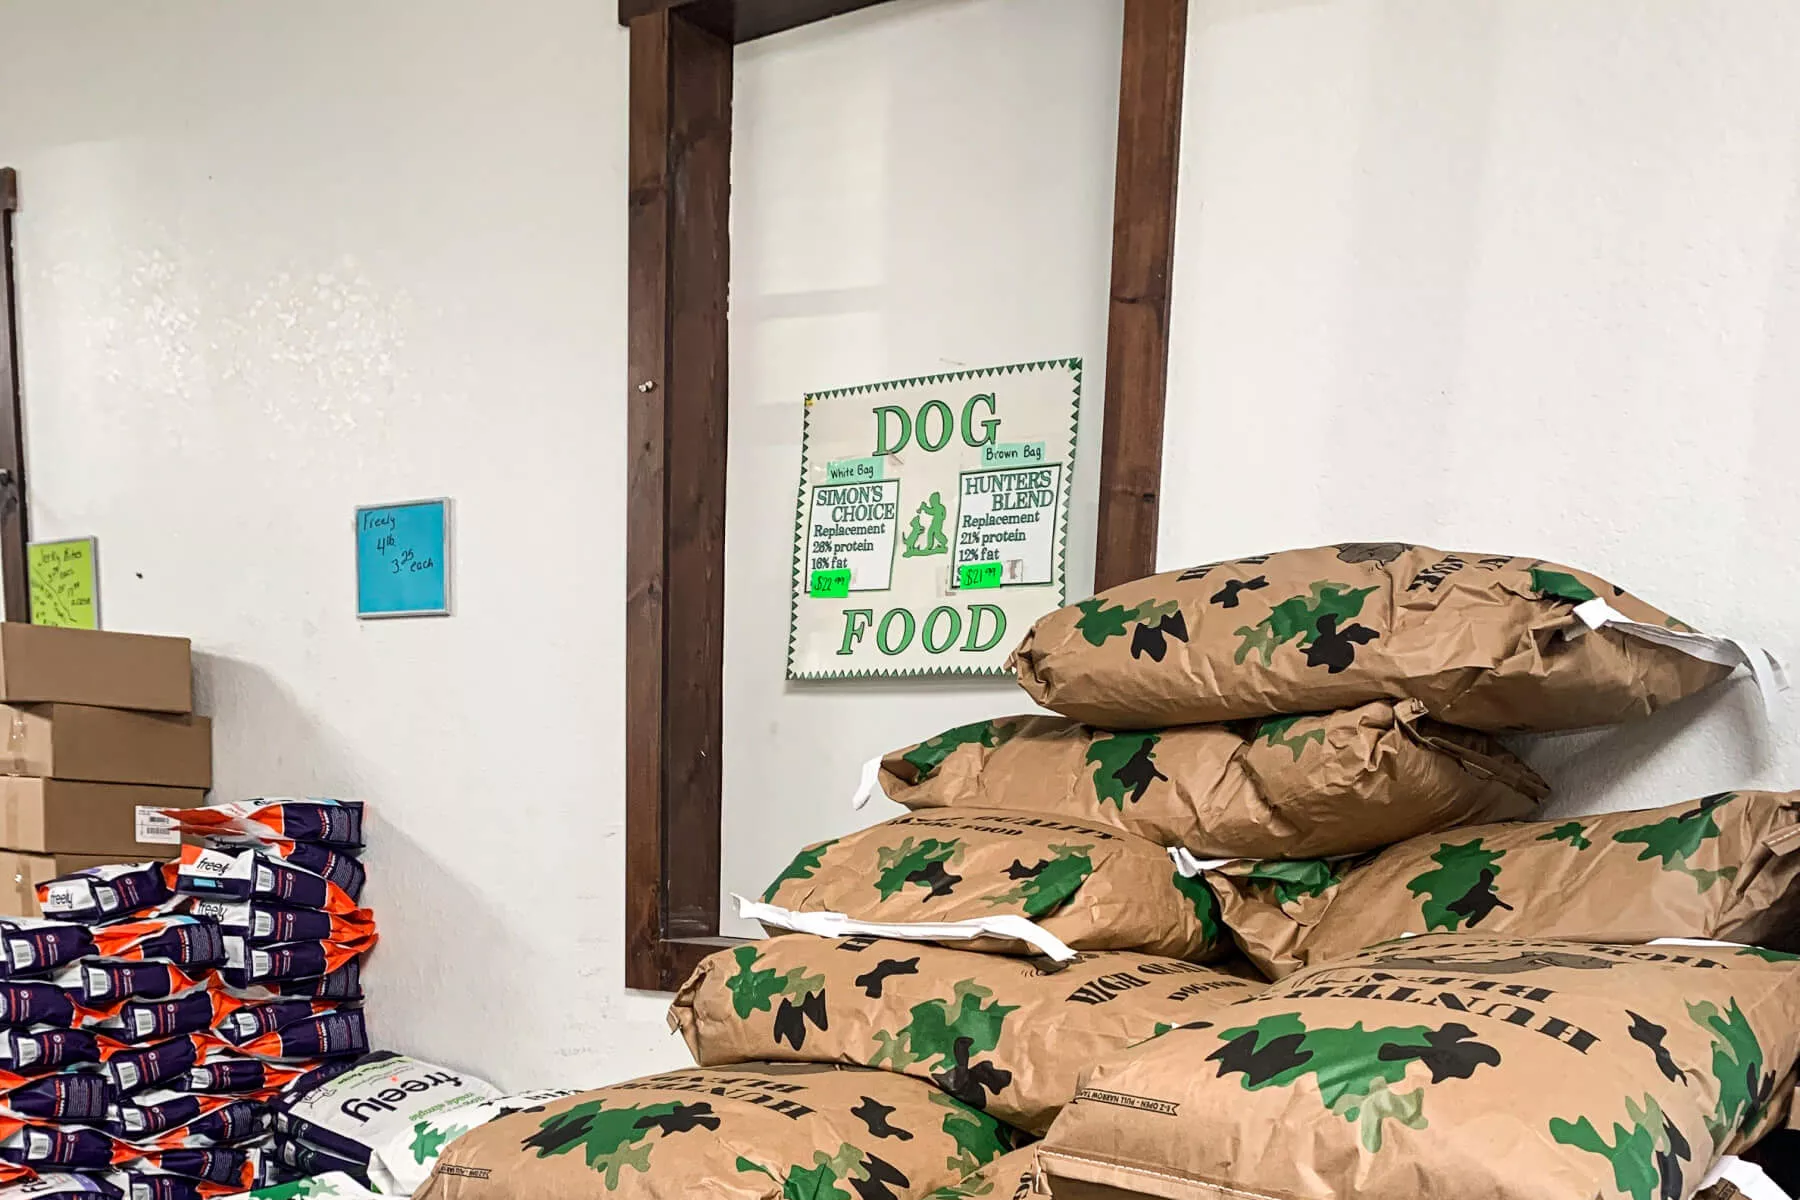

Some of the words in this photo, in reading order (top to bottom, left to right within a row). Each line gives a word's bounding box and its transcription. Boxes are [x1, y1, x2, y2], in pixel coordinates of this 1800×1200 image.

[872, 392, 1001, 456] DOG
[986, 447, 1018, 460] Brown
[1023, 445, 1042, 460] Bag
[830, 467, 854, 479] White
[857, 464, 874, 478] Bag
[816, 485, 883, 506] SIMON'S
[992, 490, 1054, 511] BLEND
[832, 503, 895, 522] CHOICE
[962, 511, 1040, 529] Replacement
[813, 523, 886, 539] Replacement
[960, 531, 980, 545] 21%
[982, 528, 1026, 546] protein
[834, 538, 874, 555] protein
[959, 548, 979, 562] 12%
[980, 547, 1000, 561] fat
[831, 556, 848, 568] fat
[836, 604, 1007, 656] FOOD
[341, 1071, 463, 1123] freely
[1090, 1091, 1119, 1103] NARROW
[1120, 1096, 1135, 1105] PULL
[1140, 1100, 1158, 1109] OPEN
